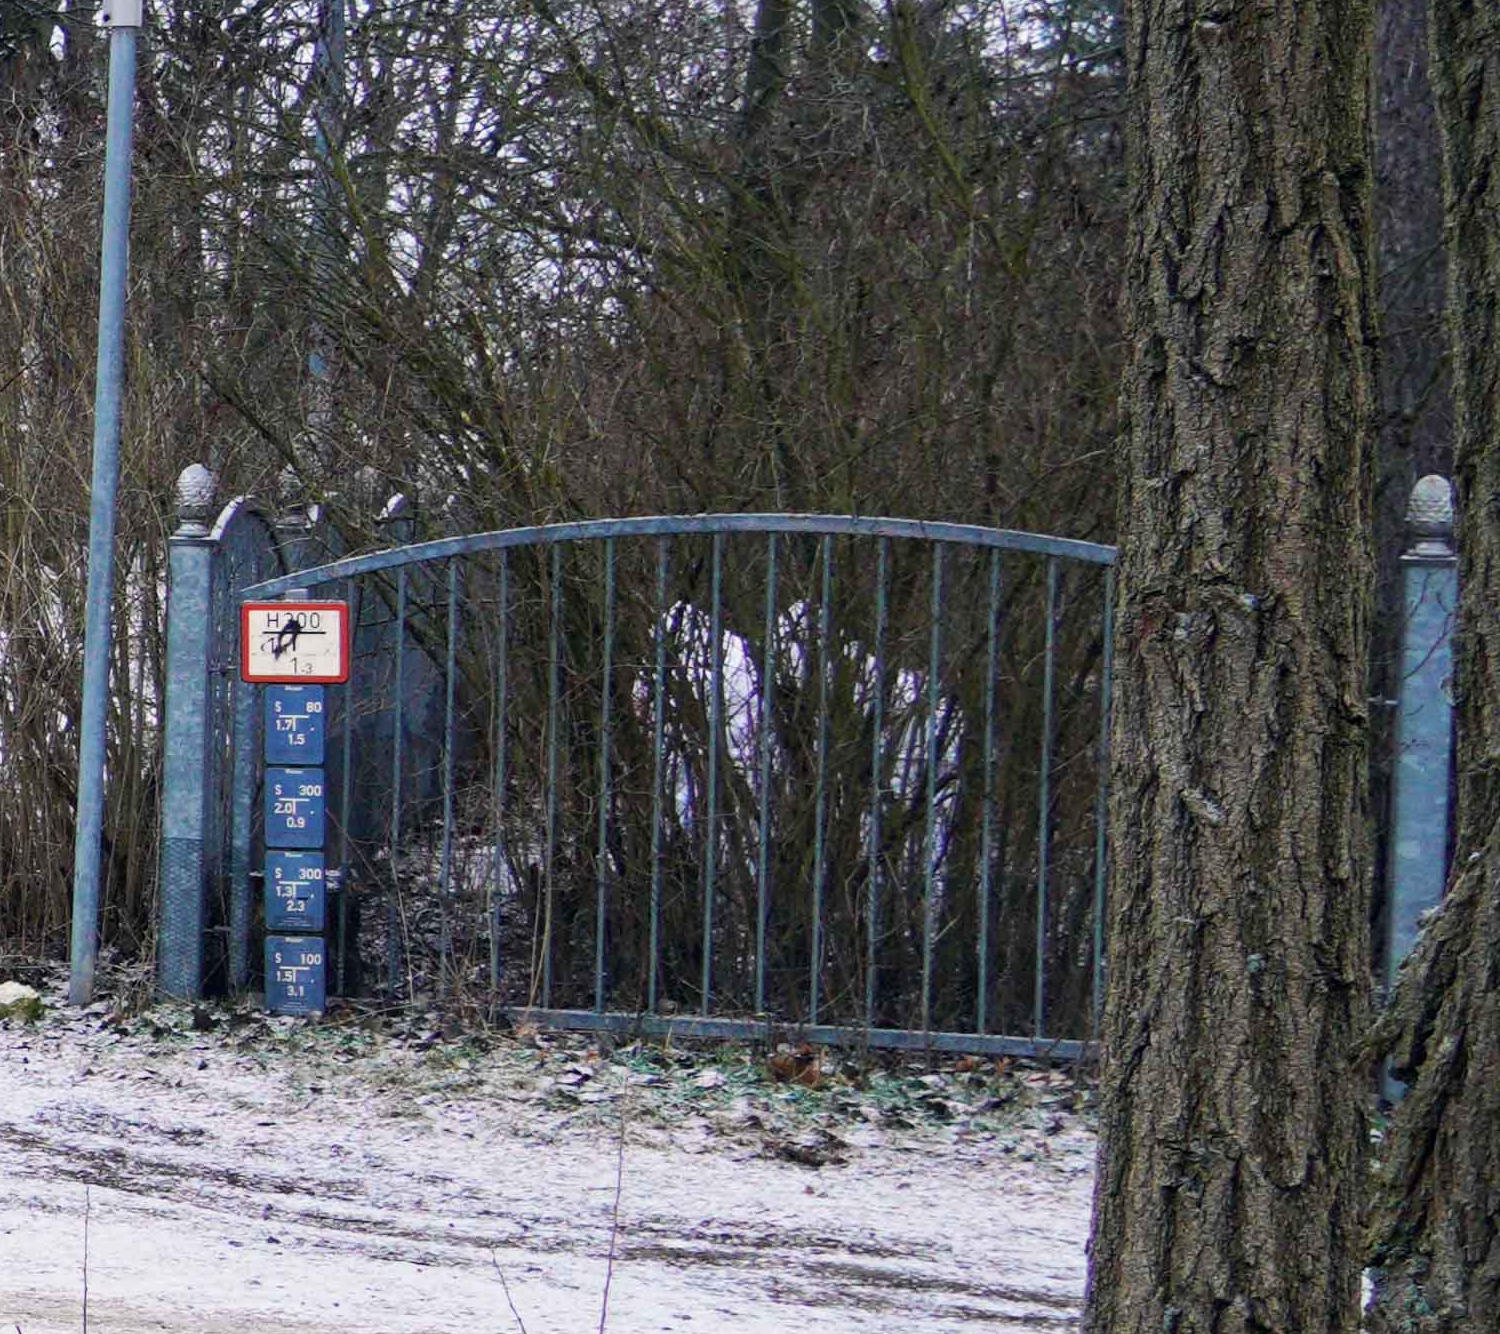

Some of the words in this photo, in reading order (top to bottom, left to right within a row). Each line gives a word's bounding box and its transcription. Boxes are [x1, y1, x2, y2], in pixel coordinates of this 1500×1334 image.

[274, 700, 282, 712] S
[306, 701, 322, 713] 80
[276, 719, 292, 731] 1.7
[288, 733, 305, 745] 1.5
[274, 784, 282, 795] S
[298, 785, 322, 796] 300
[274, 867, 282, 879] S
[298, 868, 322, 880] 300
[275, 952, 282, 964] S
[301, 953, 322, 965] 100
